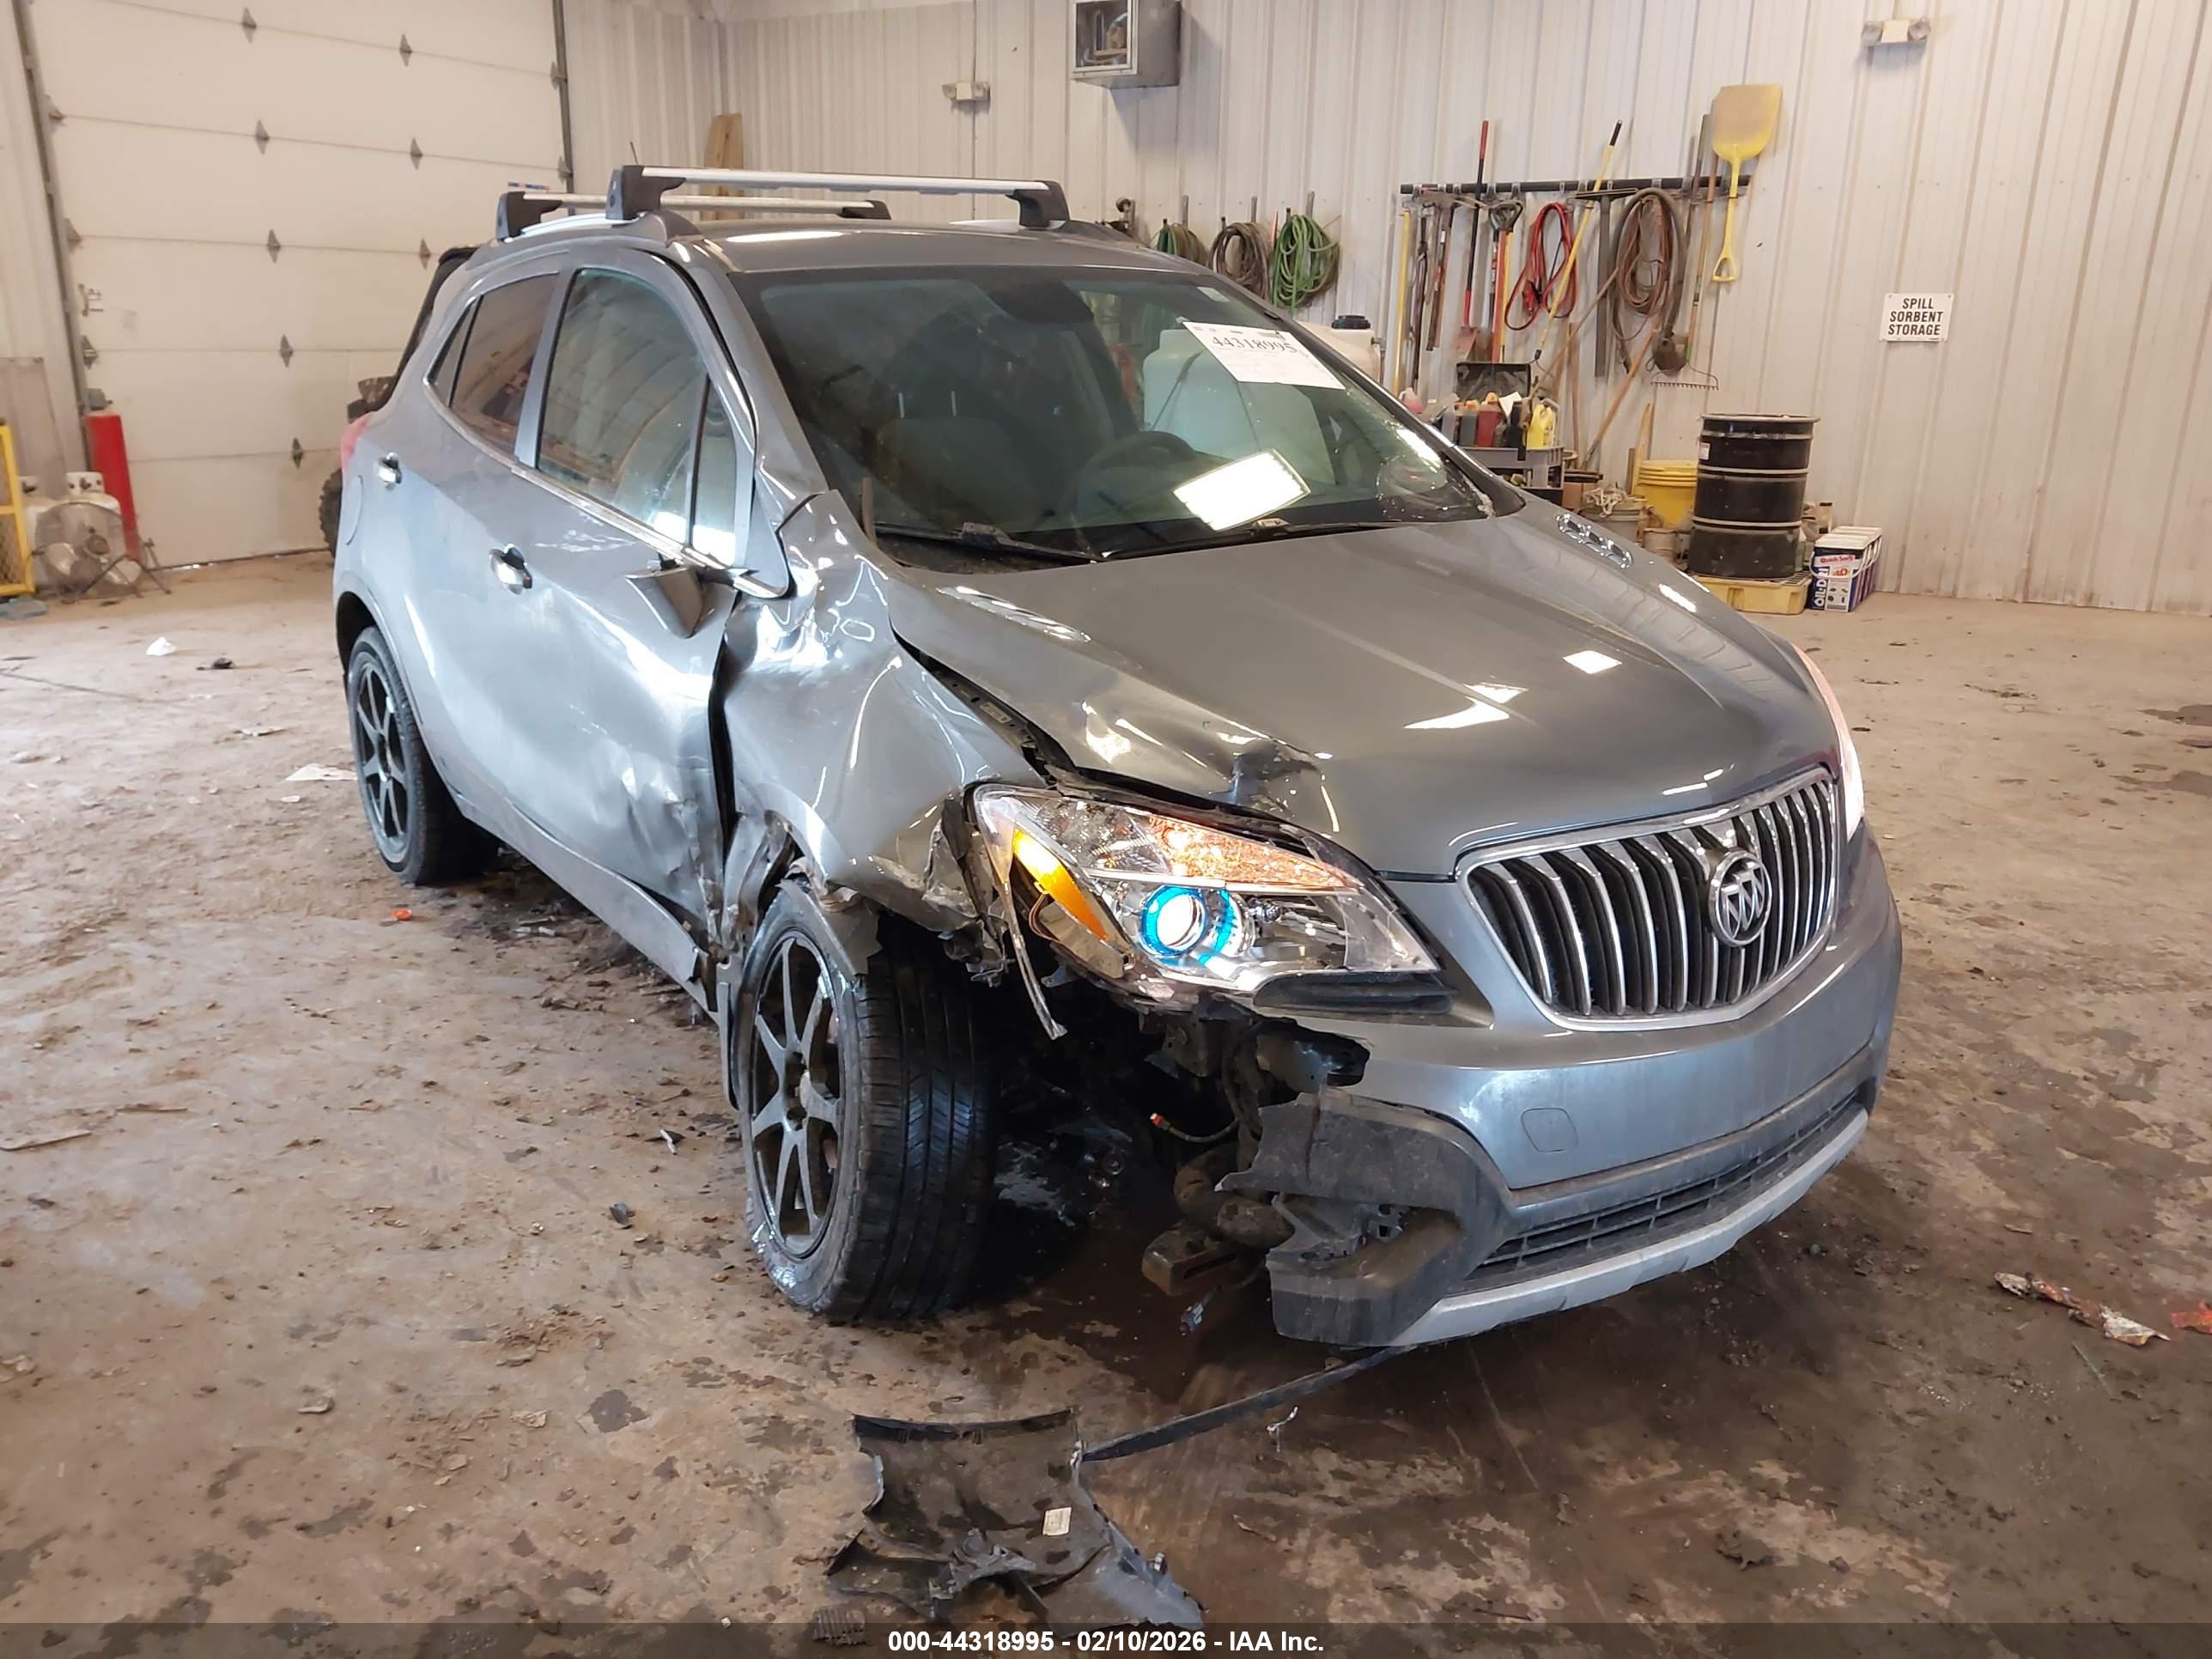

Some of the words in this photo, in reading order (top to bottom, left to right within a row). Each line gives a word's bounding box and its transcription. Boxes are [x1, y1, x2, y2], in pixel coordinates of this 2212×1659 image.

[1902, 297, 1934, 309] SPILL
[1889, 311, 1943, 322] SORBENT
[1887, 324, 1941, 335] STORAGE
